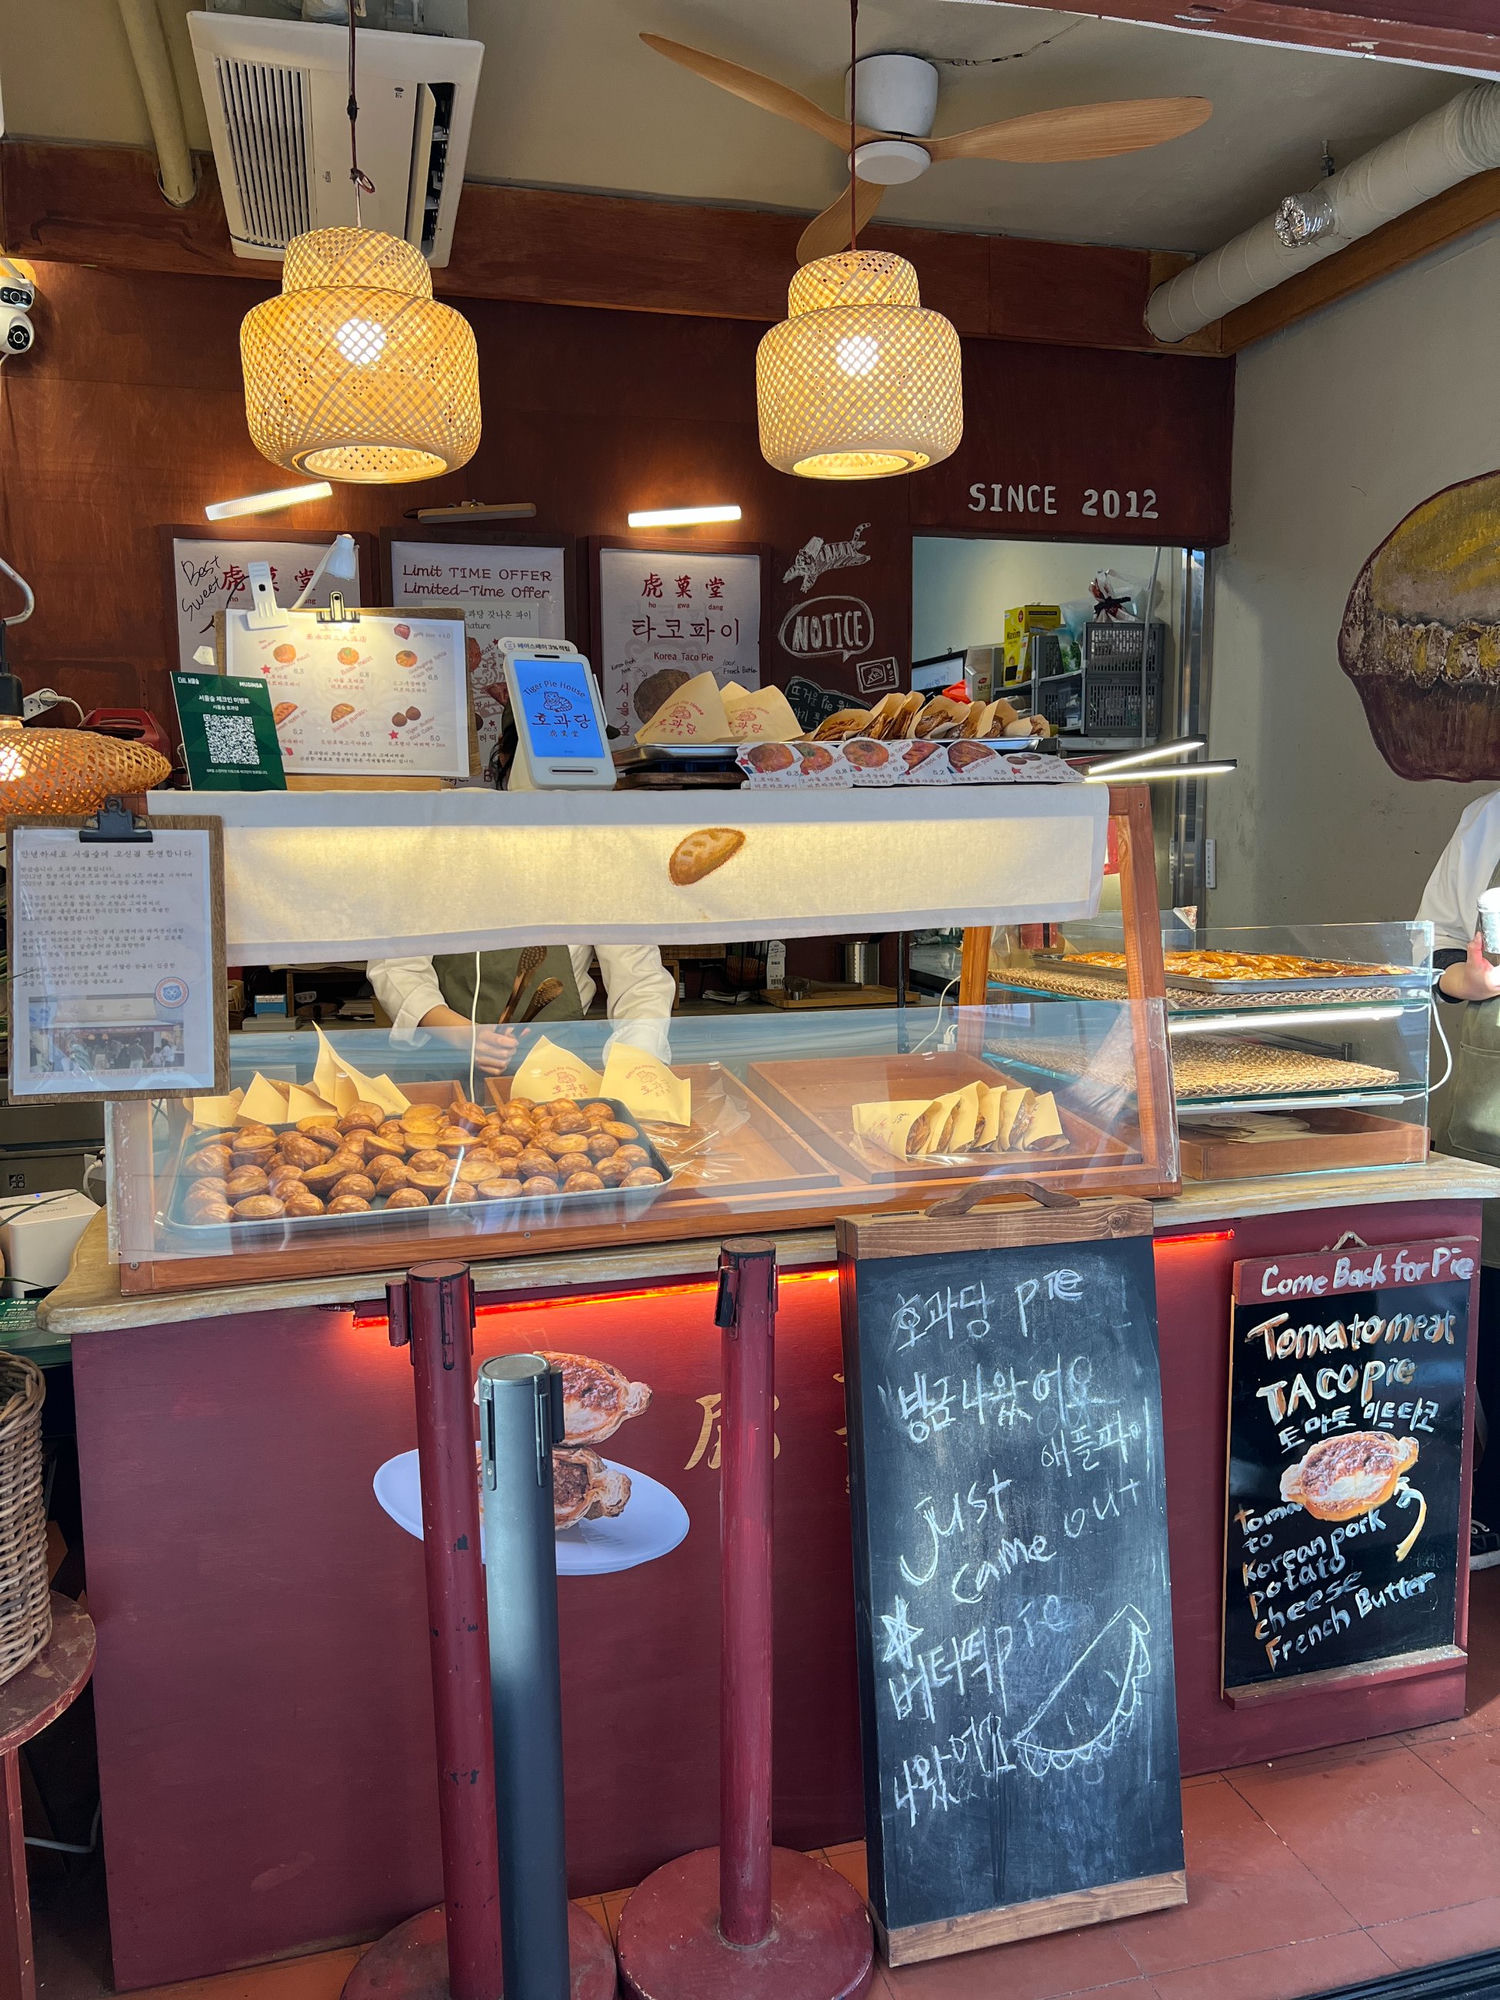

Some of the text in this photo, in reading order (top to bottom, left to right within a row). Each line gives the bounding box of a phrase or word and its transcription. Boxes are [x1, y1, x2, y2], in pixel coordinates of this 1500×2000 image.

[968, 483, 1159, 519] SINCE 2012
[181, 555, 221, 587] Best
[403, 564, 552, 581] Limit TIME OFFER
[641, 572, 725, 598] 虎菓堂
[181, 577, 221, 621] Sweet
[511, 587, 550, 599] Offer
[708, 603, 723, 611] dang
[465, 610, 484, 619] 과당
[631, 615, 740, 645] 타코파이
[792, 610, 863, 651] NOTICE
[653, 652, 714, 662] Korea Taco Pie
[199, 695, 215, 703] 서울숲
[523, 680, 586, 698] Tiger Pie House
[532, 712, 591, 729] 호과당
[21, 849, 67, 859] 안녕하세요
[72, 849, 109, 859] 서울숲에
[1261, 1247, 1475, 1296] Come Back for Pie
[892, 1280, 995, 1352] 호과당
[1041, 1396, 1150, 1478] 애플파이
[1278, 1405, 1357, 1454] 토마토
[1064, 1478, 1141, 1539] out
[1242, 1533, 1274, 1553] to
[1250, 1554, 1346, 1620] potato
[1265, 1572, 1436, 1672] French Butter
